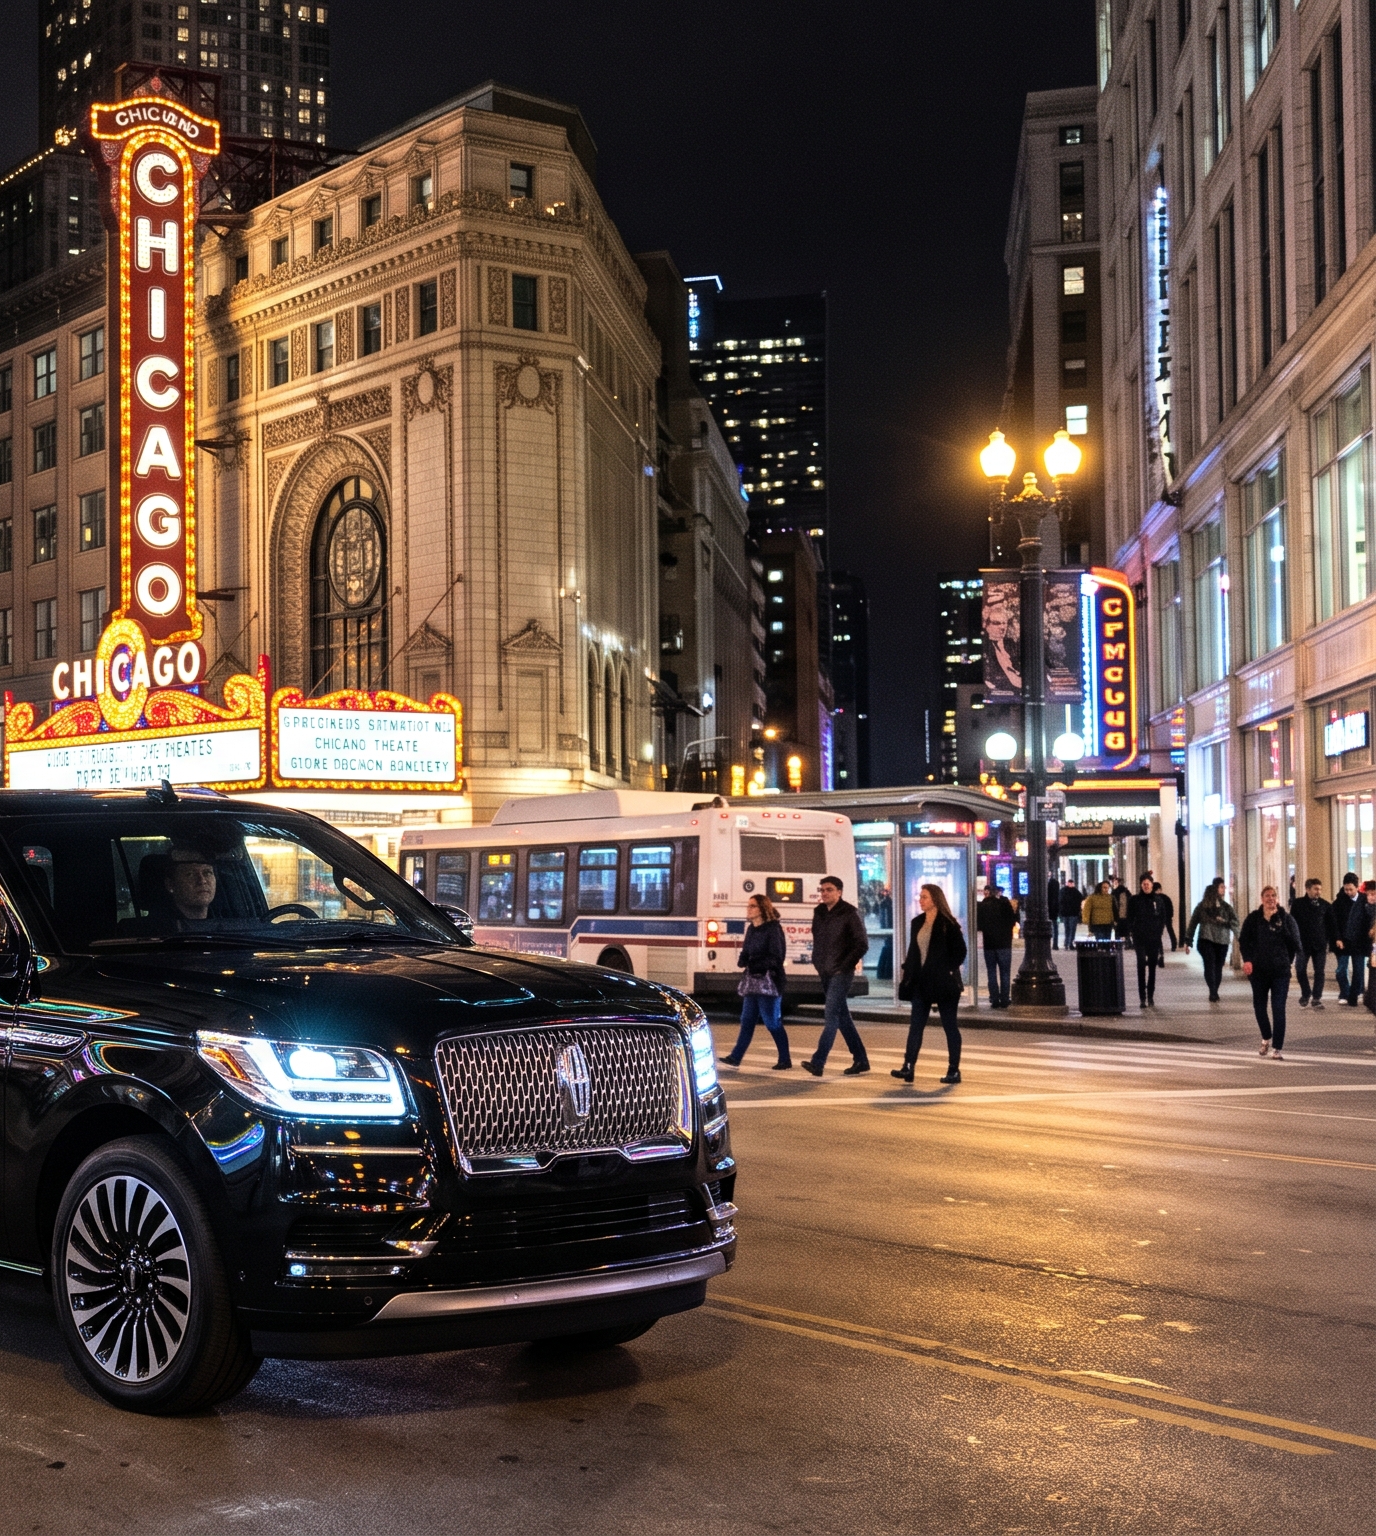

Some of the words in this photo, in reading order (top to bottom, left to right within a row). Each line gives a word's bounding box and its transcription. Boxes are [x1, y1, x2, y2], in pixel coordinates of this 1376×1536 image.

[134, 151, 182, 618] CHICAGO
[52, 641, 201, 700] CHICAGO
[315, 737, 366, 751] CHICANO
[374, 739, 419, 752] THEATE
